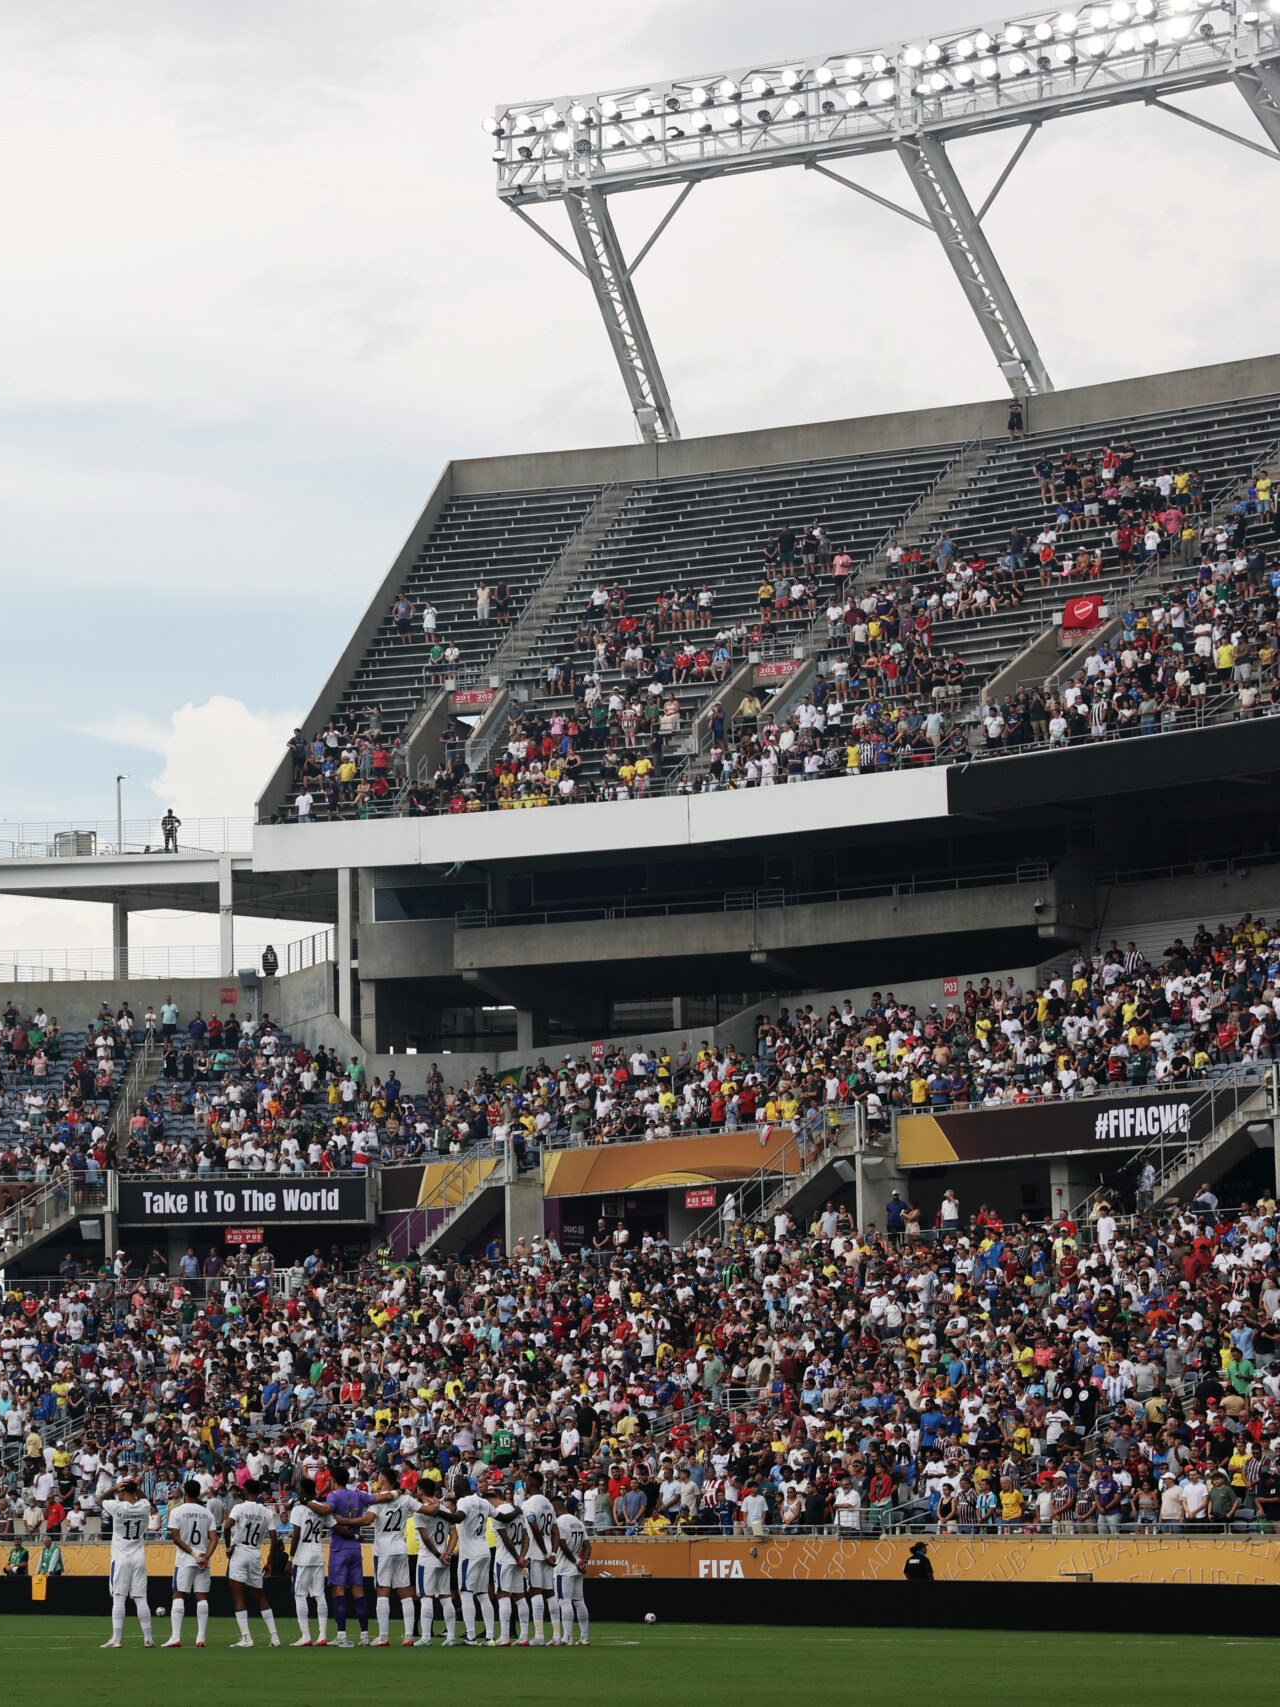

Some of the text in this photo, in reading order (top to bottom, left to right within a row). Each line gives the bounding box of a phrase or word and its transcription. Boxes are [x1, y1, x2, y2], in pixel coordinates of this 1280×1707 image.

[944, 982, 958, 993] P03
[592, 1046, 604, 1055] P02
[143, 1188, 339, 1214] Take It To The World
[499, 1437, 510, 1447] 10
[123, 1519, 142, 1540] 11
[302, 1518, 321, 1544] 24
[383, 1508, 402, 1532] 22
[434, 1520, 445, 1545] 8
[475, 1512, 485, 1537] 3
[540, 1512, 553, 1537] 28
[190, 1520, 201, 1546] 6
[241, 1522, 260, 1547] 16
[510, 1521, 523, 1546] 20
[571, 1531, 584, 1553] 77
[698, 1559, 745, 1578] FIFA
